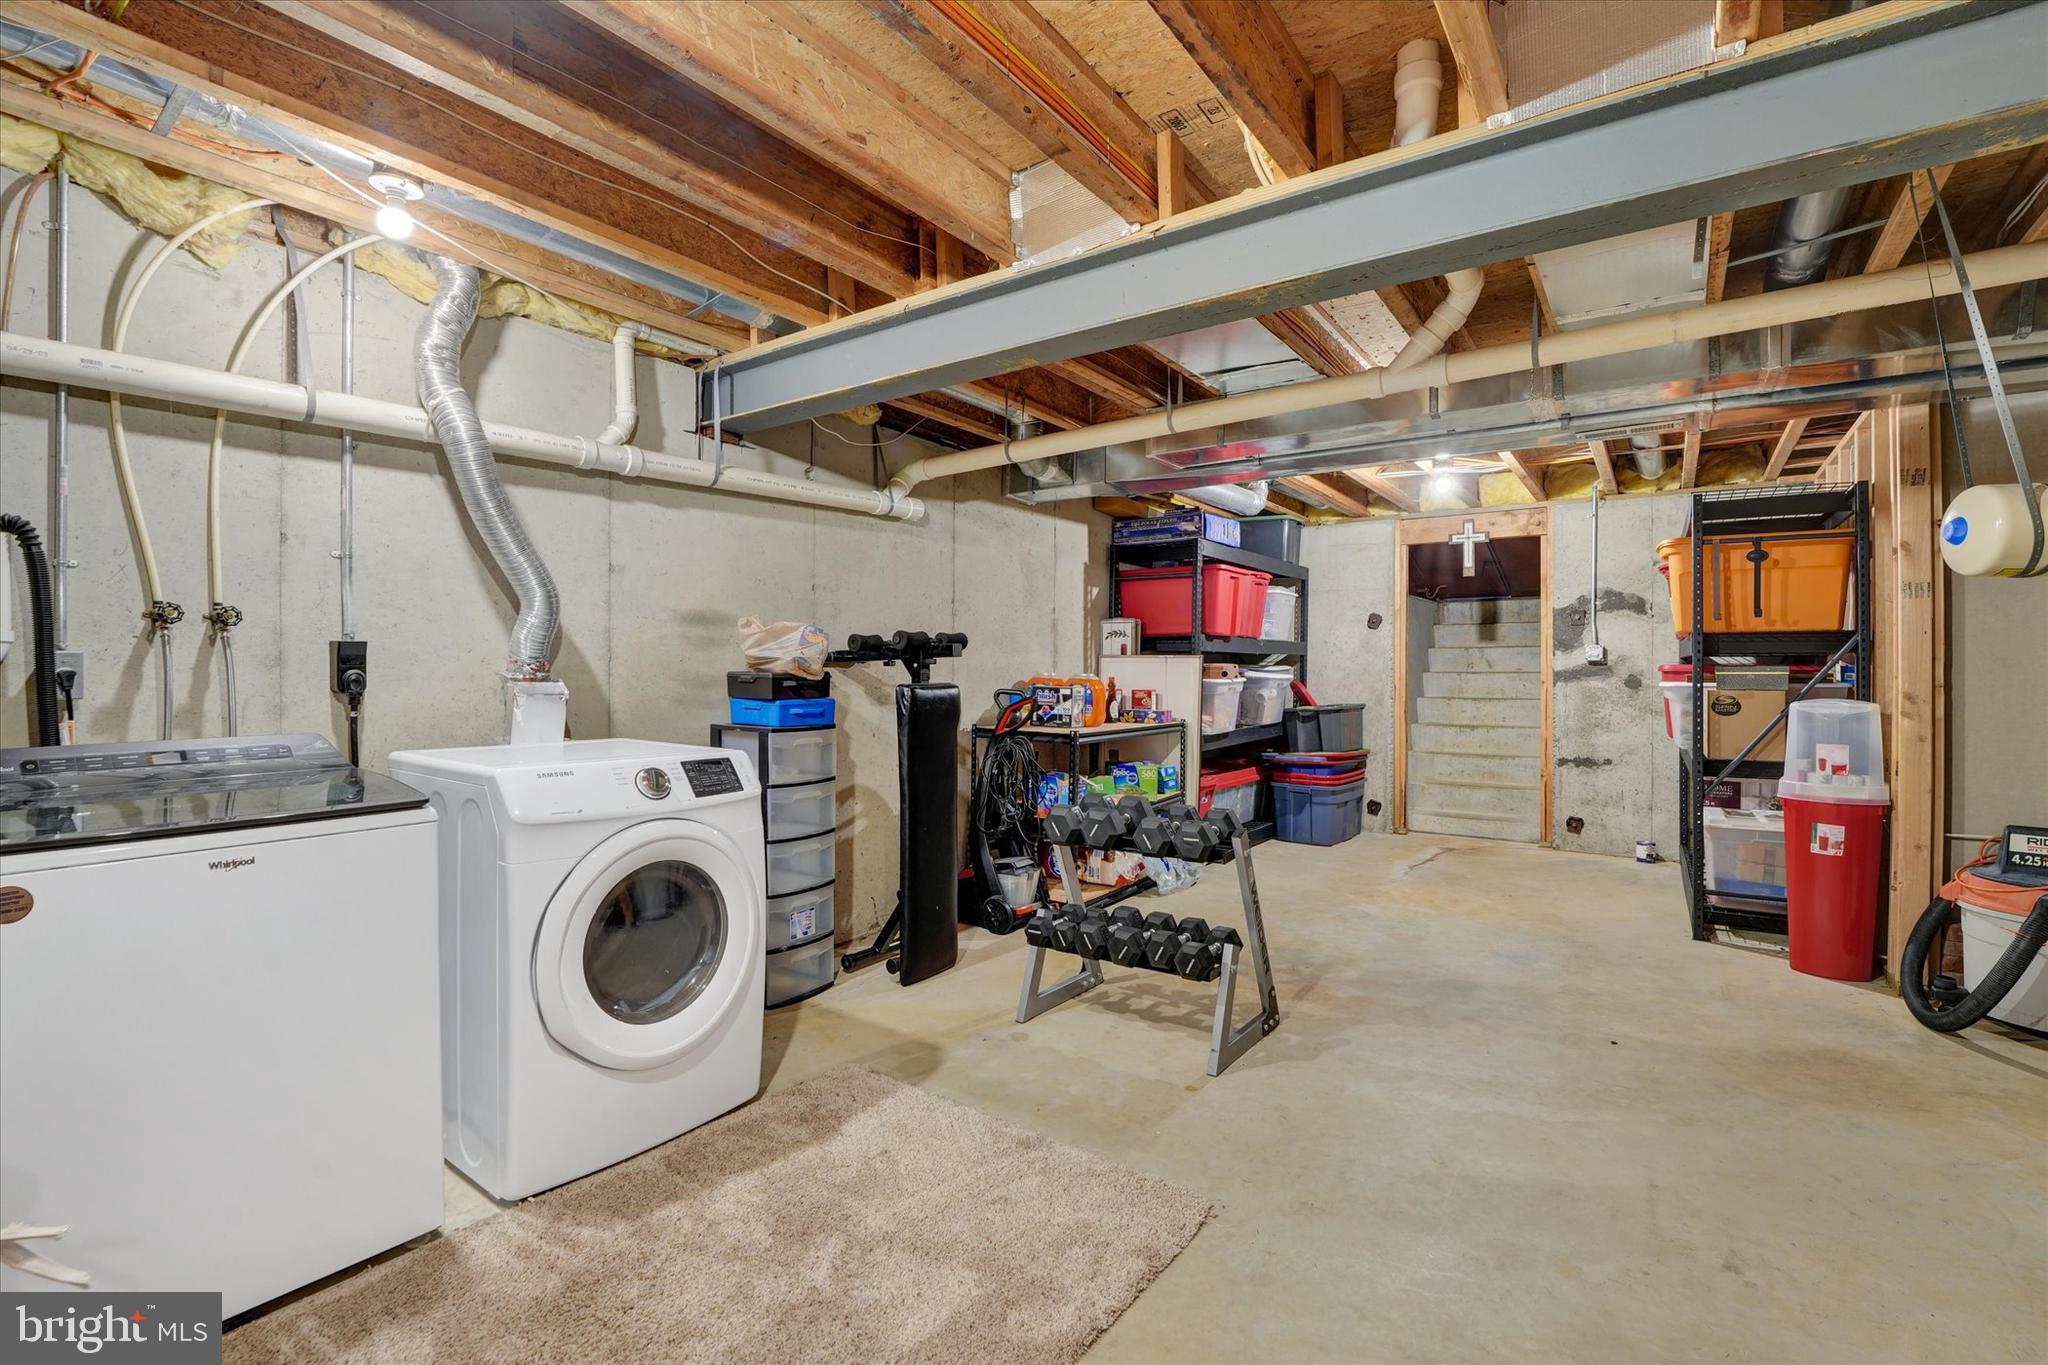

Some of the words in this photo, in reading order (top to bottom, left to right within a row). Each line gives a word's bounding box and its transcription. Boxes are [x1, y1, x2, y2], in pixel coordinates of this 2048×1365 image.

[536, 770, 575, 779] SAMSUNG
[208, 856, 255, 871] Whirlpool
[2011, 854, 2042, 867] 4.25
